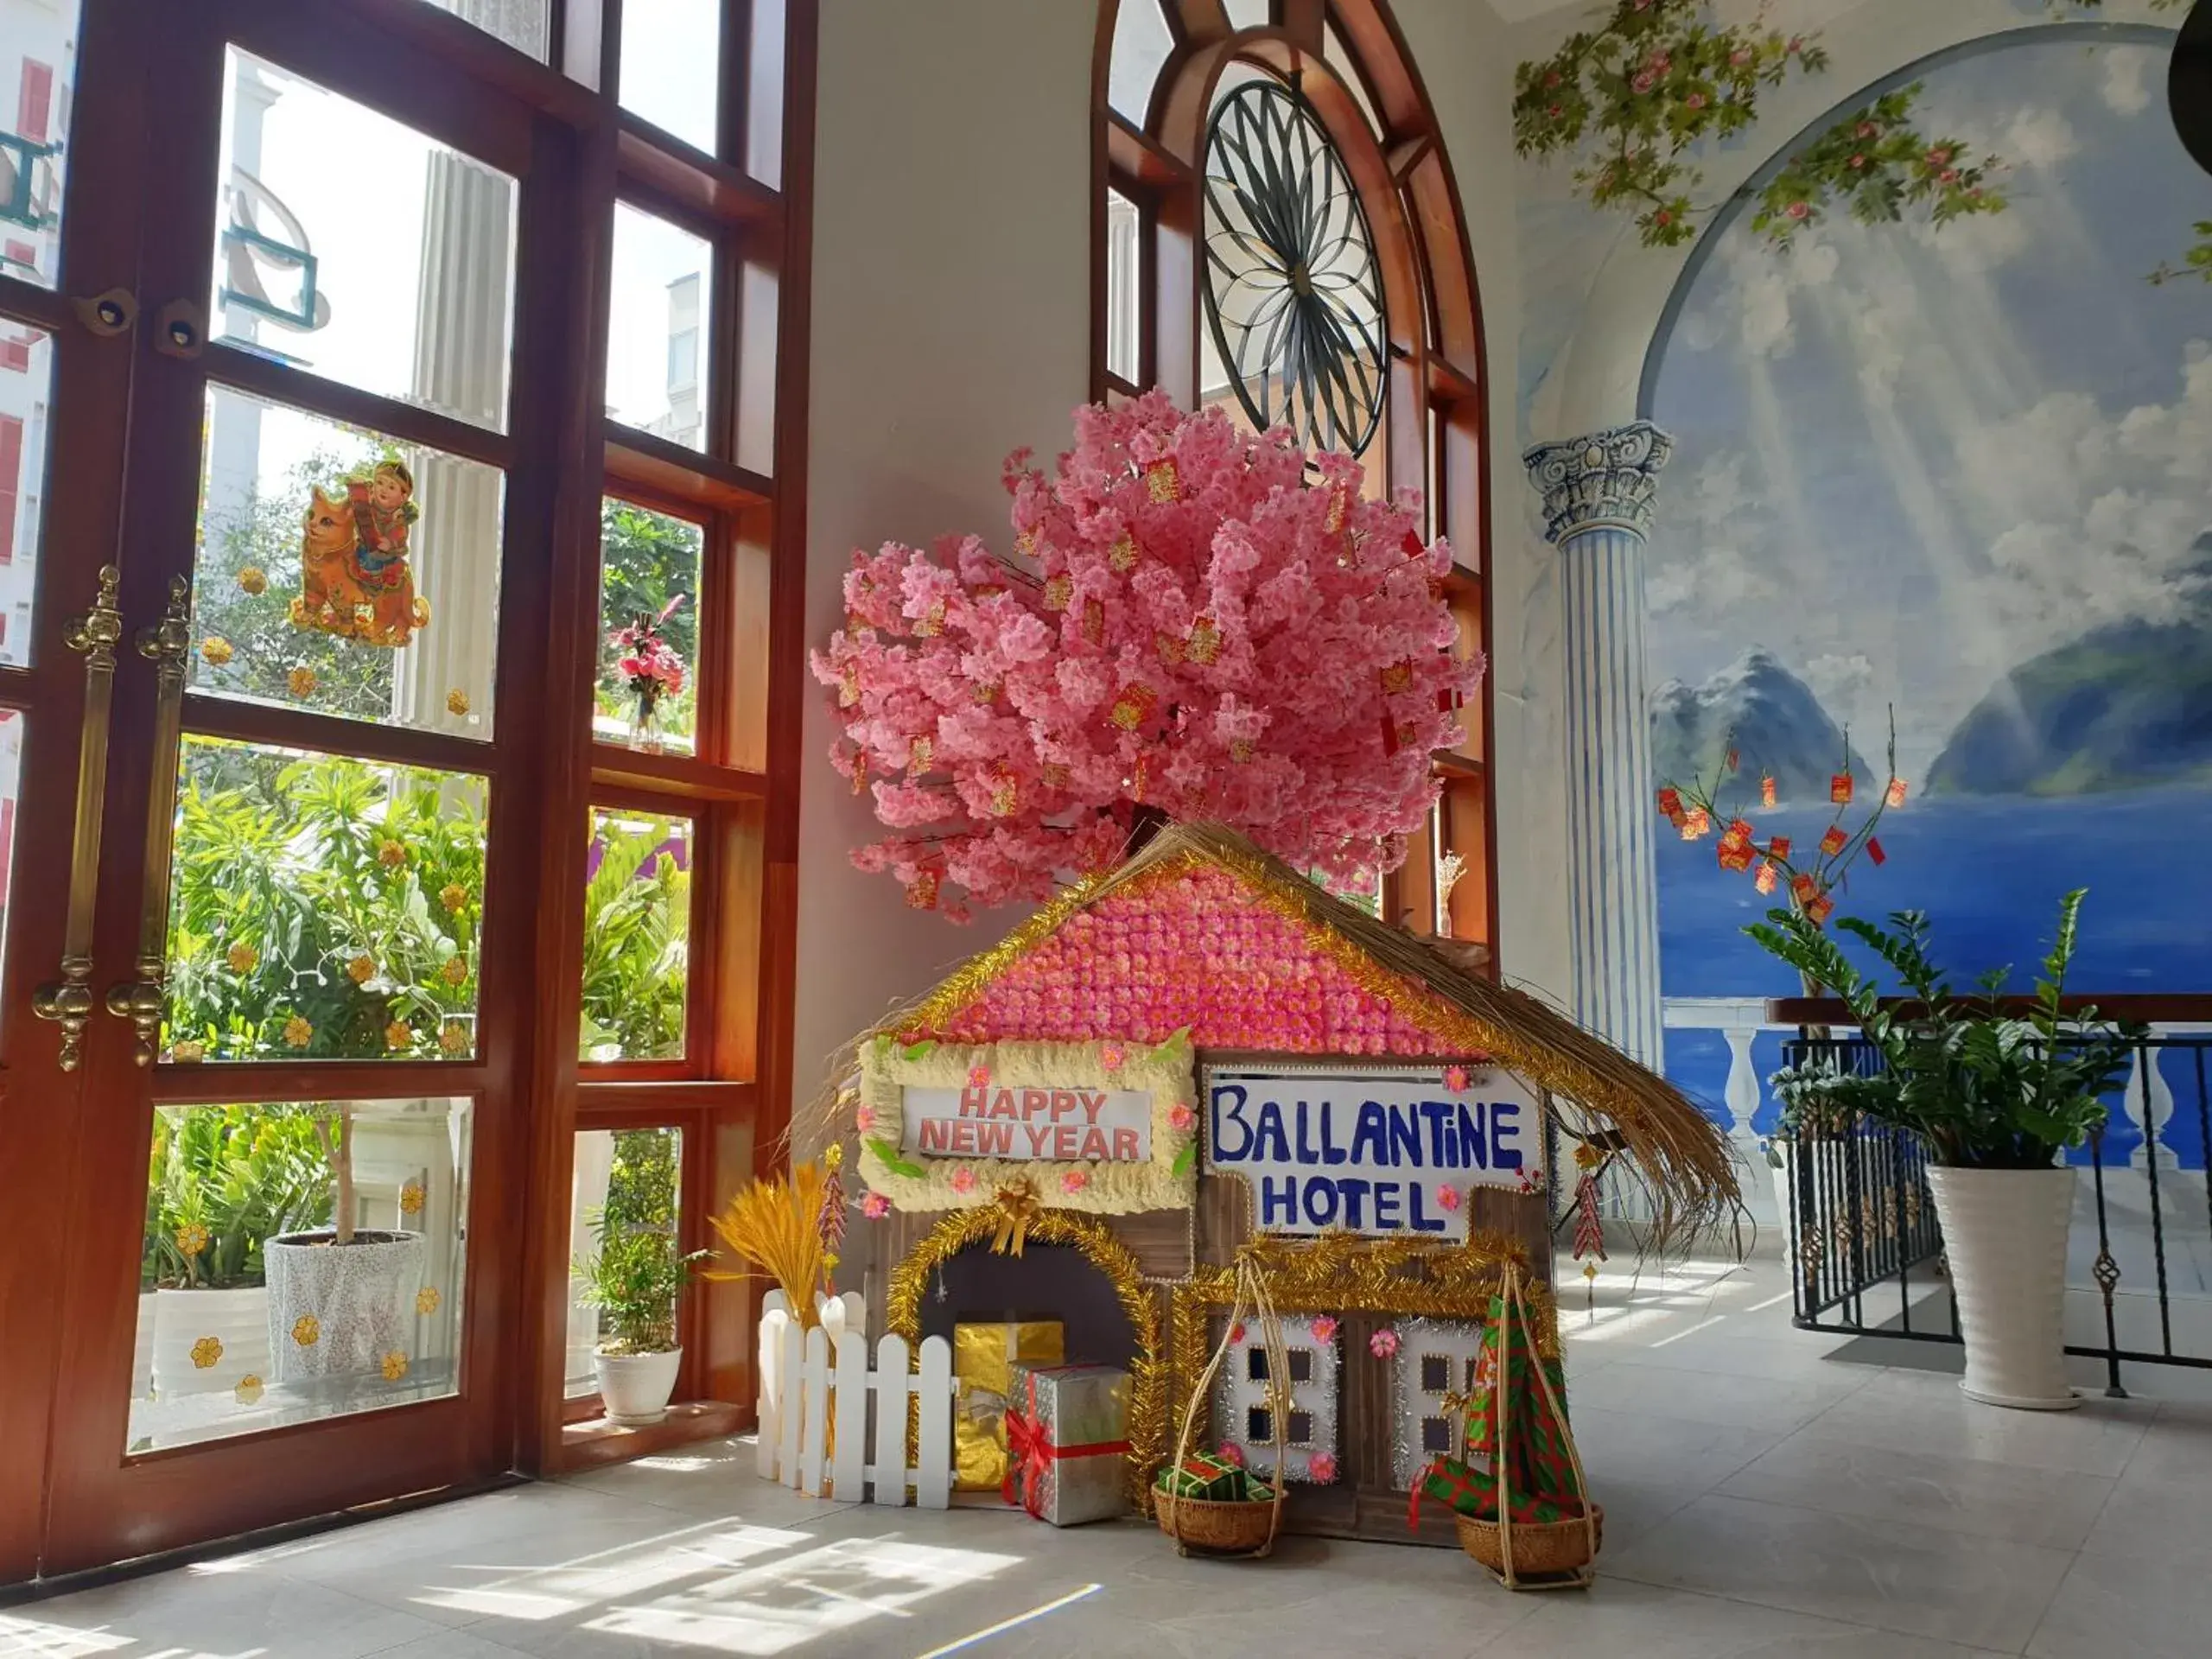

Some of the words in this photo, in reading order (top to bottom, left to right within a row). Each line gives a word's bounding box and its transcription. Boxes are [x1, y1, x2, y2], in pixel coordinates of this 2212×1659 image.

[959, 1088, 1108, 1124] HAPPY
[918, 1119, 1014, 1154] NEW
[1023, 1125, 1140, 1160] YEAR
[1262, 1175, 1446, 1231] HOTEL
